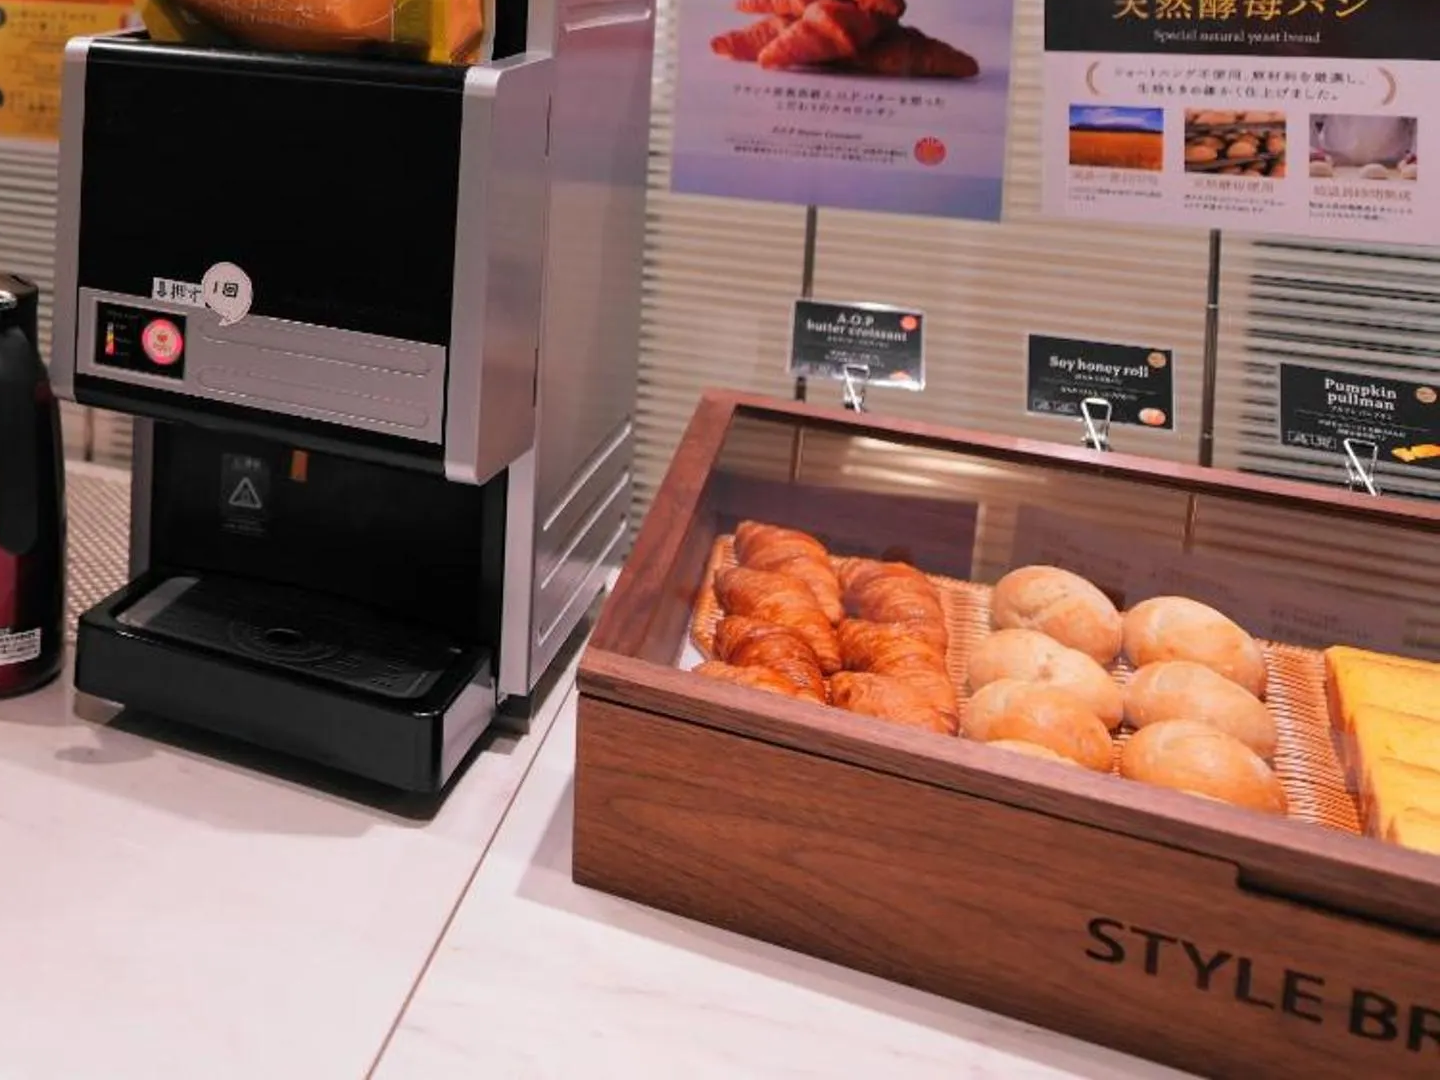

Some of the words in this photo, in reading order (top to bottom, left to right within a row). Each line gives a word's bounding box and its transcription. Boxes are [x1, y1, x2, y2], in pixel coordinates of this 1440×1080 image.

[1153, 29, 1197, 43] Special
[805, 318, 847, 335] butter
[848, 326, 908, 341] croissant
[1048, 356, 1076, 372] Soy
[1077, 358, 1121, 376] honey
[1123, 365, 1150, 378] roll
[1324, 377, 1397, 399] Pumpkin
[1327, 392, 1396, 411] pullman
[1084, 917, 1327, 1024] STYLE
